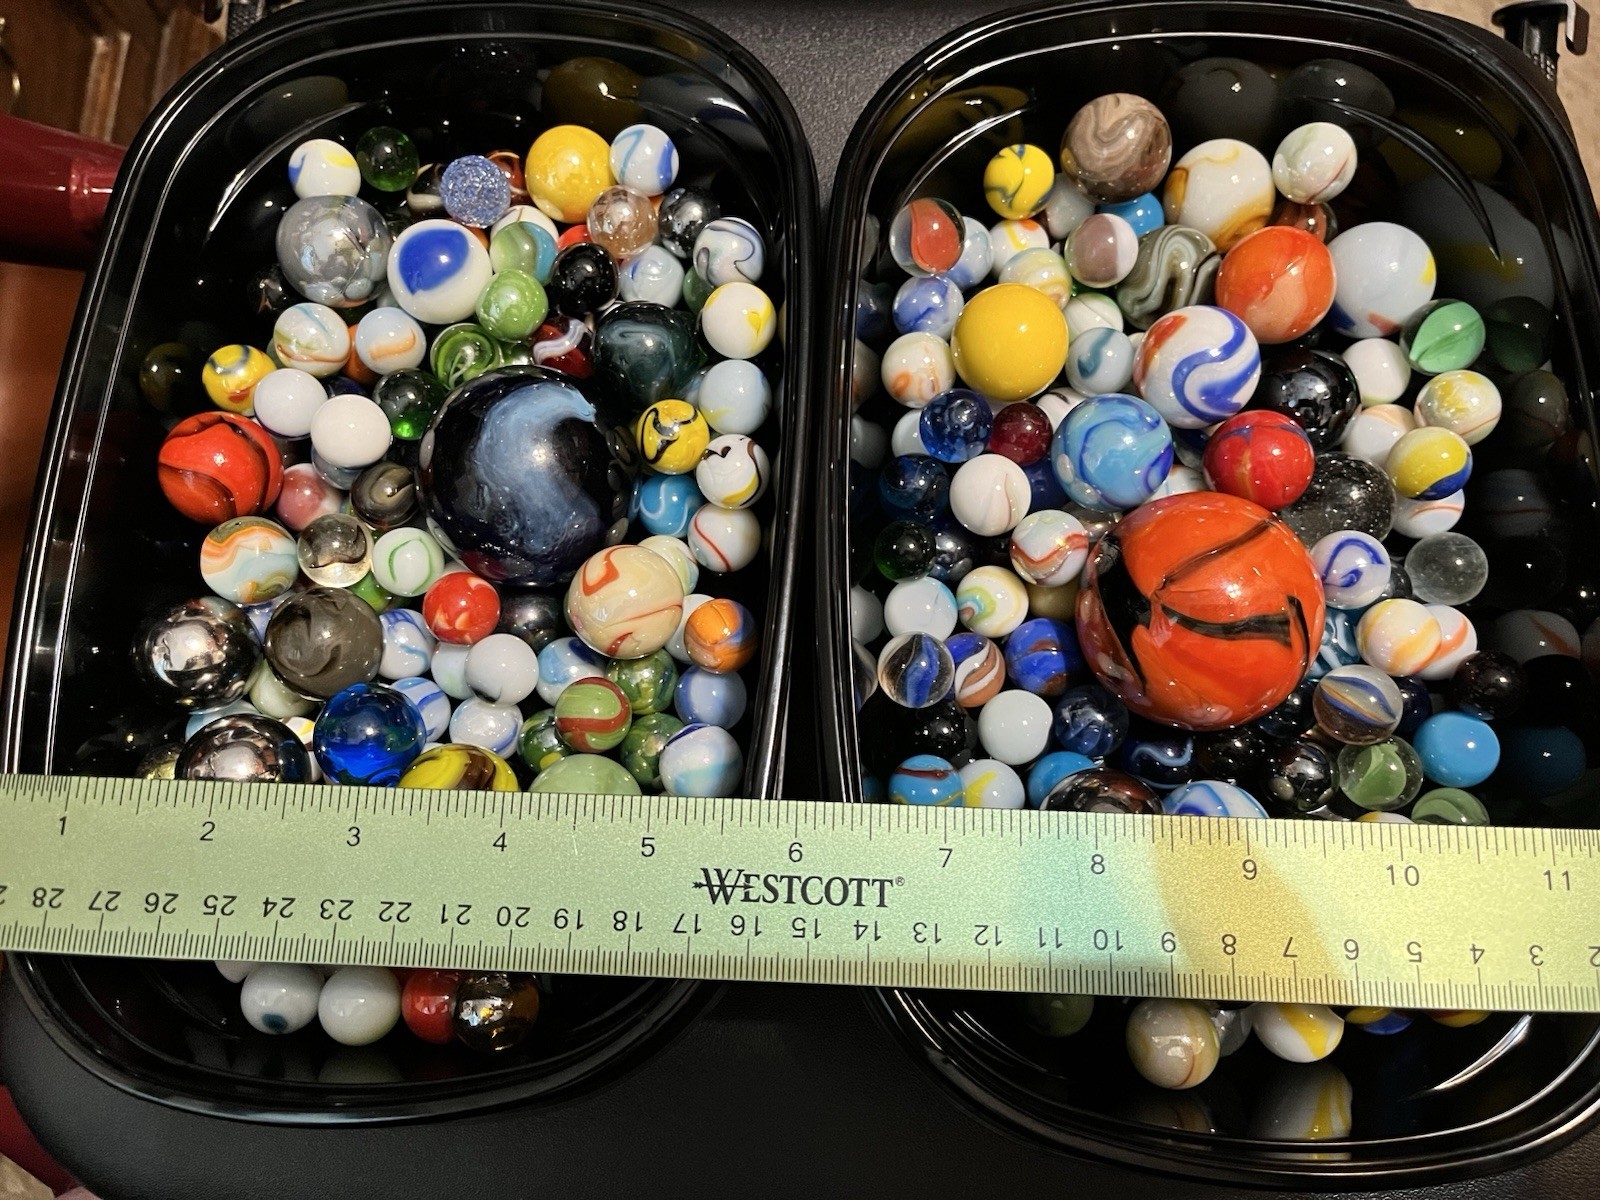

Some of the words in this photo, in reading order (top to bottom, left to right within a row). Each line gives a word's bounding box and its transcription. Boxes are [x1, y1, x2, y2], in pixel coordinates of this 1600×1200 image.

[58, 816, 67, 836] 1
[199, 821, 216, 841] 2
[346, 826, 361, 847] 3
[492, 832, 507, 852] 4
[640, 837, 655, 858] 5
[788, 841, 803, 863] 6
[938, 848, 953, 868] 7
[1090, 854, 1105, 875] 8
[1241, 859, 1257, 880] 9
[1386, 865, 1420, 887] 10
[1543, 870, 1571, 891] 11
[32, 886, 65, 910] 28
[88, 890, 122, 912] 27
[144, 892, 180, 914] 26
[203, 895, 238, 917] 25
[262, 897, 297, 919] 24
[320, 899, 355, 921] 23
[378, 901, 413, 923] 22
[440, 904, 473, 926] 21
[496, 906, 531, 928] 20
[553, 908, 585, 930] 19
[613, 910, 644, 932] 18
[672, 913, 702, 934] 17
[731, 915, 762, 937] 16
[792, 917, 822, 939] 15
[853, 919, 882, 941] 14
[913, 922, 942, 944] 13
[974, 924, 1003, 946] 12
[1038, 927, 1063, 949] 11
[1093, 929, 1124, 951] 10
[1161, 931, 1176, 953] 9
[1221, 934, 1237, 955] 8
[1282, 937, 1298, 958] 7
[1343, 938, 1359, 960] 6
[1407, 941, 1423, 963] 5
[1469, 944, 1485, 964] 4
[1529, 945, 1544, 966] 3
